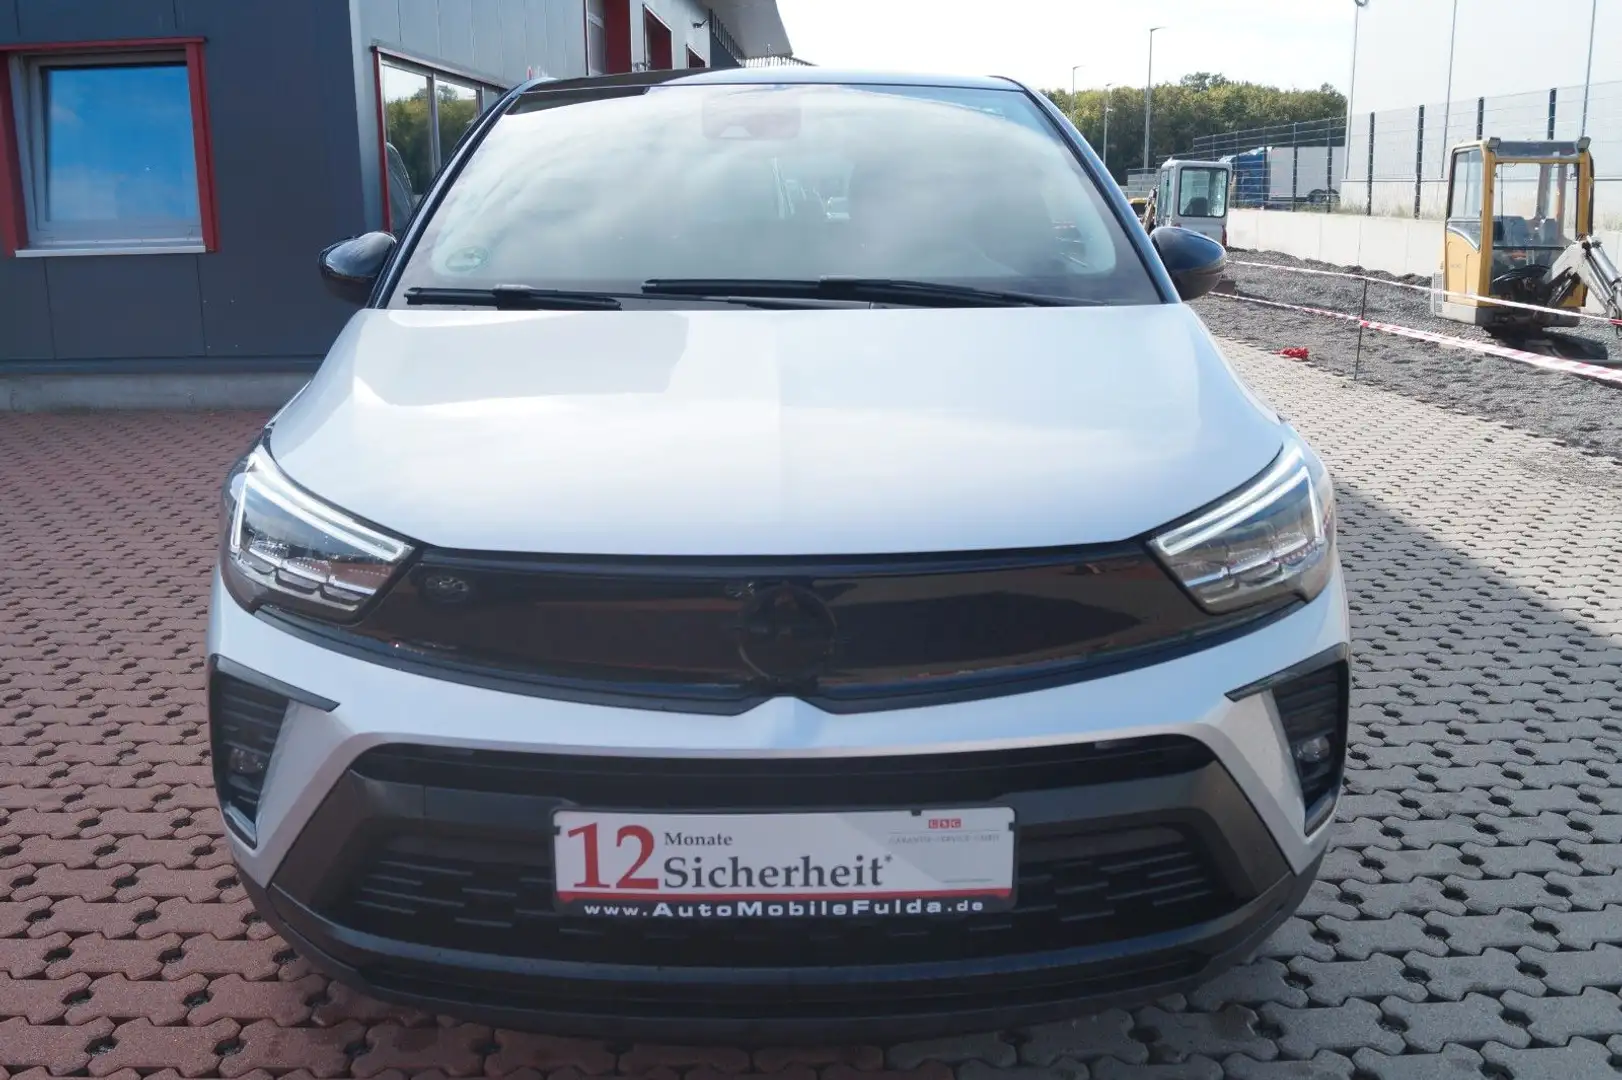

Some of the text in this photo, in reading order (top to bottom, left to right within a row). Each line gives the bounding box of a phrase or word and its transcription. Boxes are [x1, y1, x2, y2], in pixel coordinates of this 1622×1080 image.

[664, 832, 733, 847] Monate
[567, 822, 660, 890] 12
[584, 900, 983, 918] www.AutoMobileFulda.de
